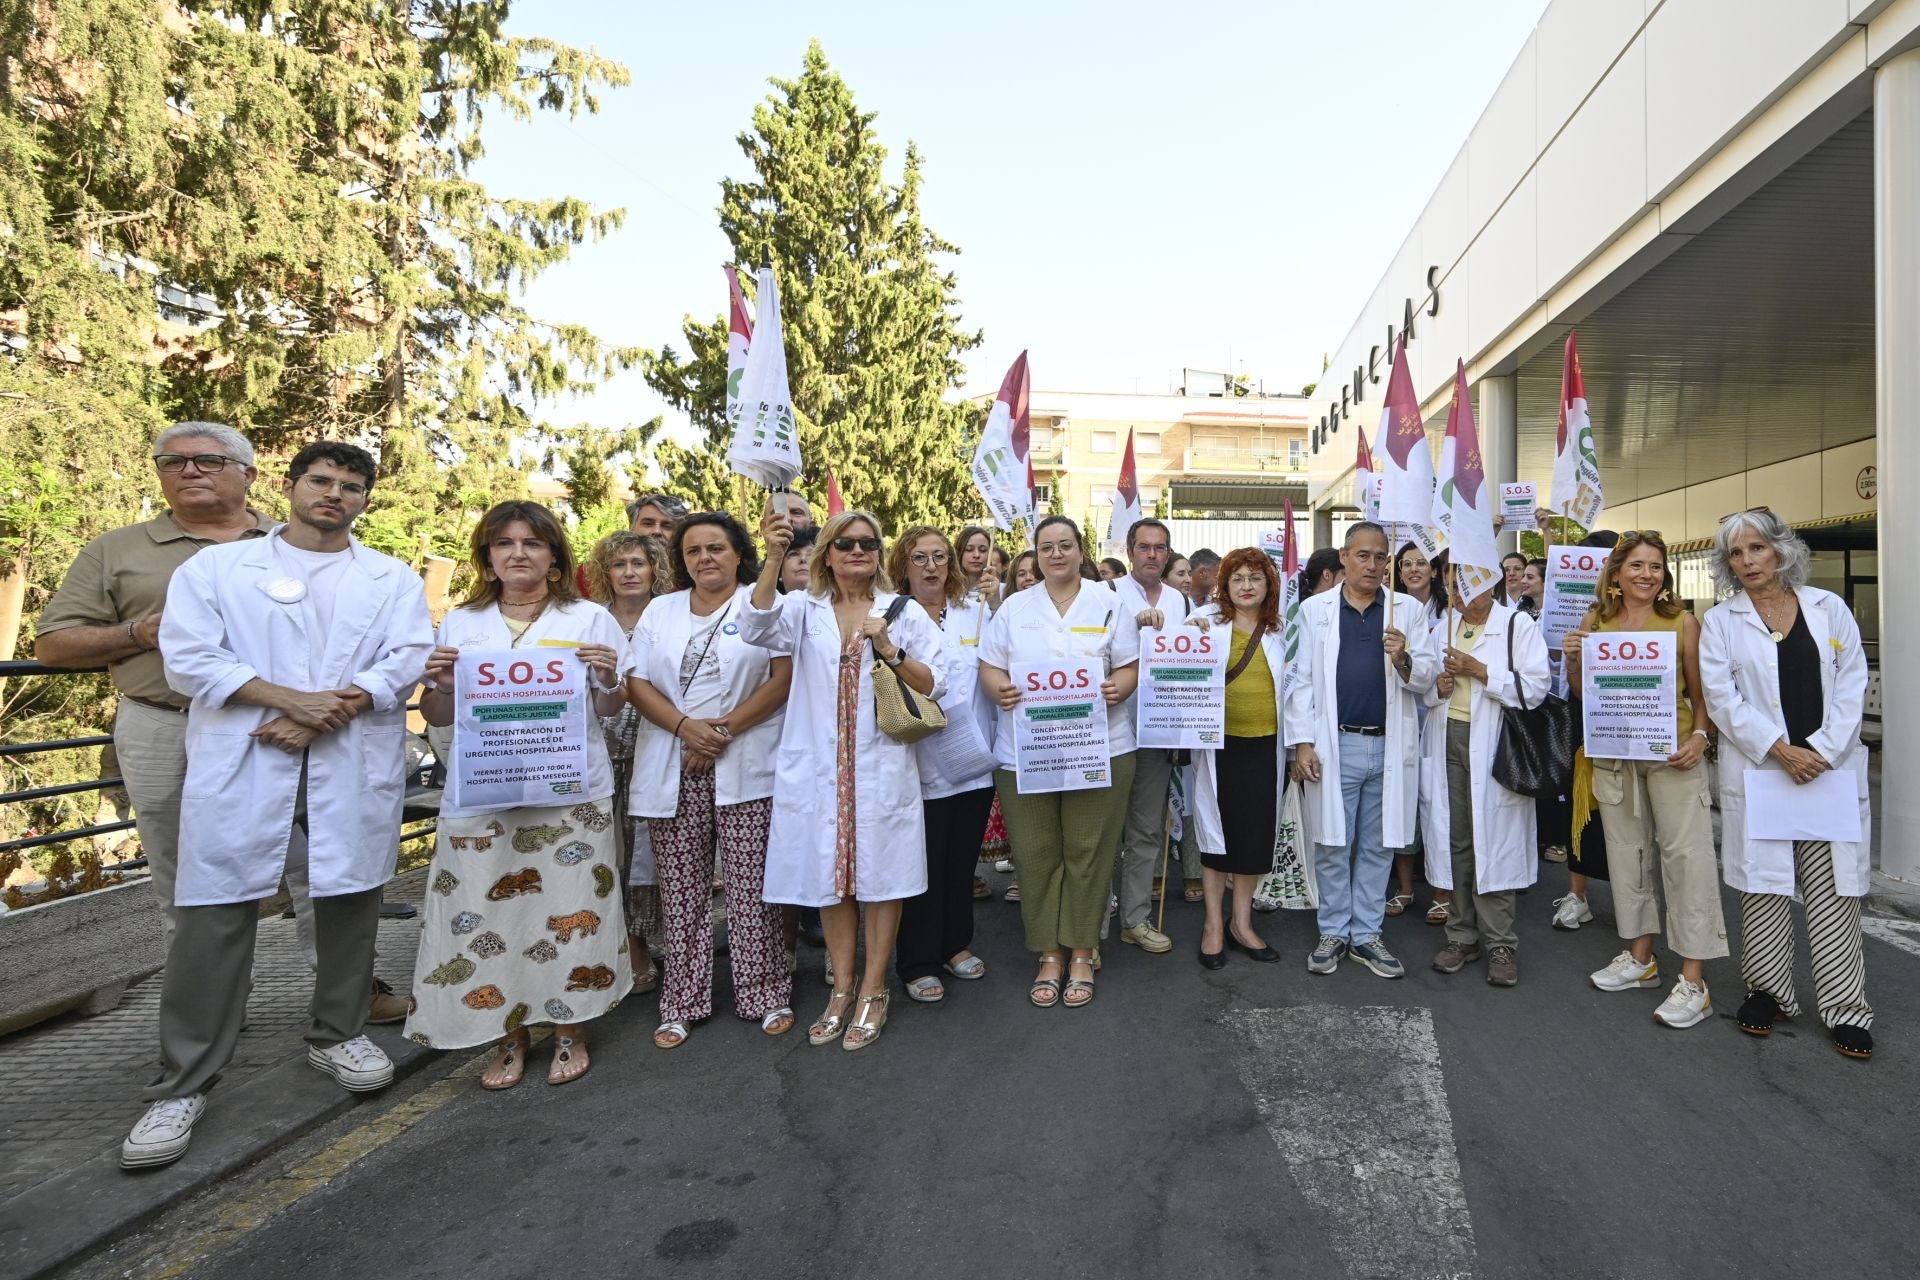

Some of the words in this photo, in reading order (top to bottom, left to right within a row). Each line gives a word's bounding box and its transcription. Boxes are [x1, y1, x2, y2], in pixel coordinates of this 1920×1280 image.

[1312, 265, 1439, 454] URGENCIAS
[1506, 486, 1530, 494] S.O.S
[1586, 495, 1601, 524] Murcia
[1266, 534, 1284, 543] S.O
[1411, 523, 1436, 552] Murcia
[1154, 636, 1211, 653] S.O.S
[1598, 642, 1659, 660] S.O.S
[478, 661, 564, 686] S.O.S
[1027, 669, 1089, 691] S.O.S
[465, 692, 510, 700] URGENCIAS
[513, 689, 574, 698] HOSPITALARIAS
[480, 728, 552, 737] CONCENTRACIÓN
[1031, 725, 1083, 733] CONCENTRACIÓN
[483, 738, 550, 747] PROFESIONALES
[1034, 733, 1082, 742] PROFESIONALES
[1058, 740, 1104, 748] HOSPITALARIAS
[466, 749, 513, 758] URGENCIAS
[516, 745, 581, 755] HOSPITALARIAS
[474, 768, 502, 776] VIERNES
[466, 778, 502, 786] HOSPITAL
[543, 772, 581, 781] MESEGUER
